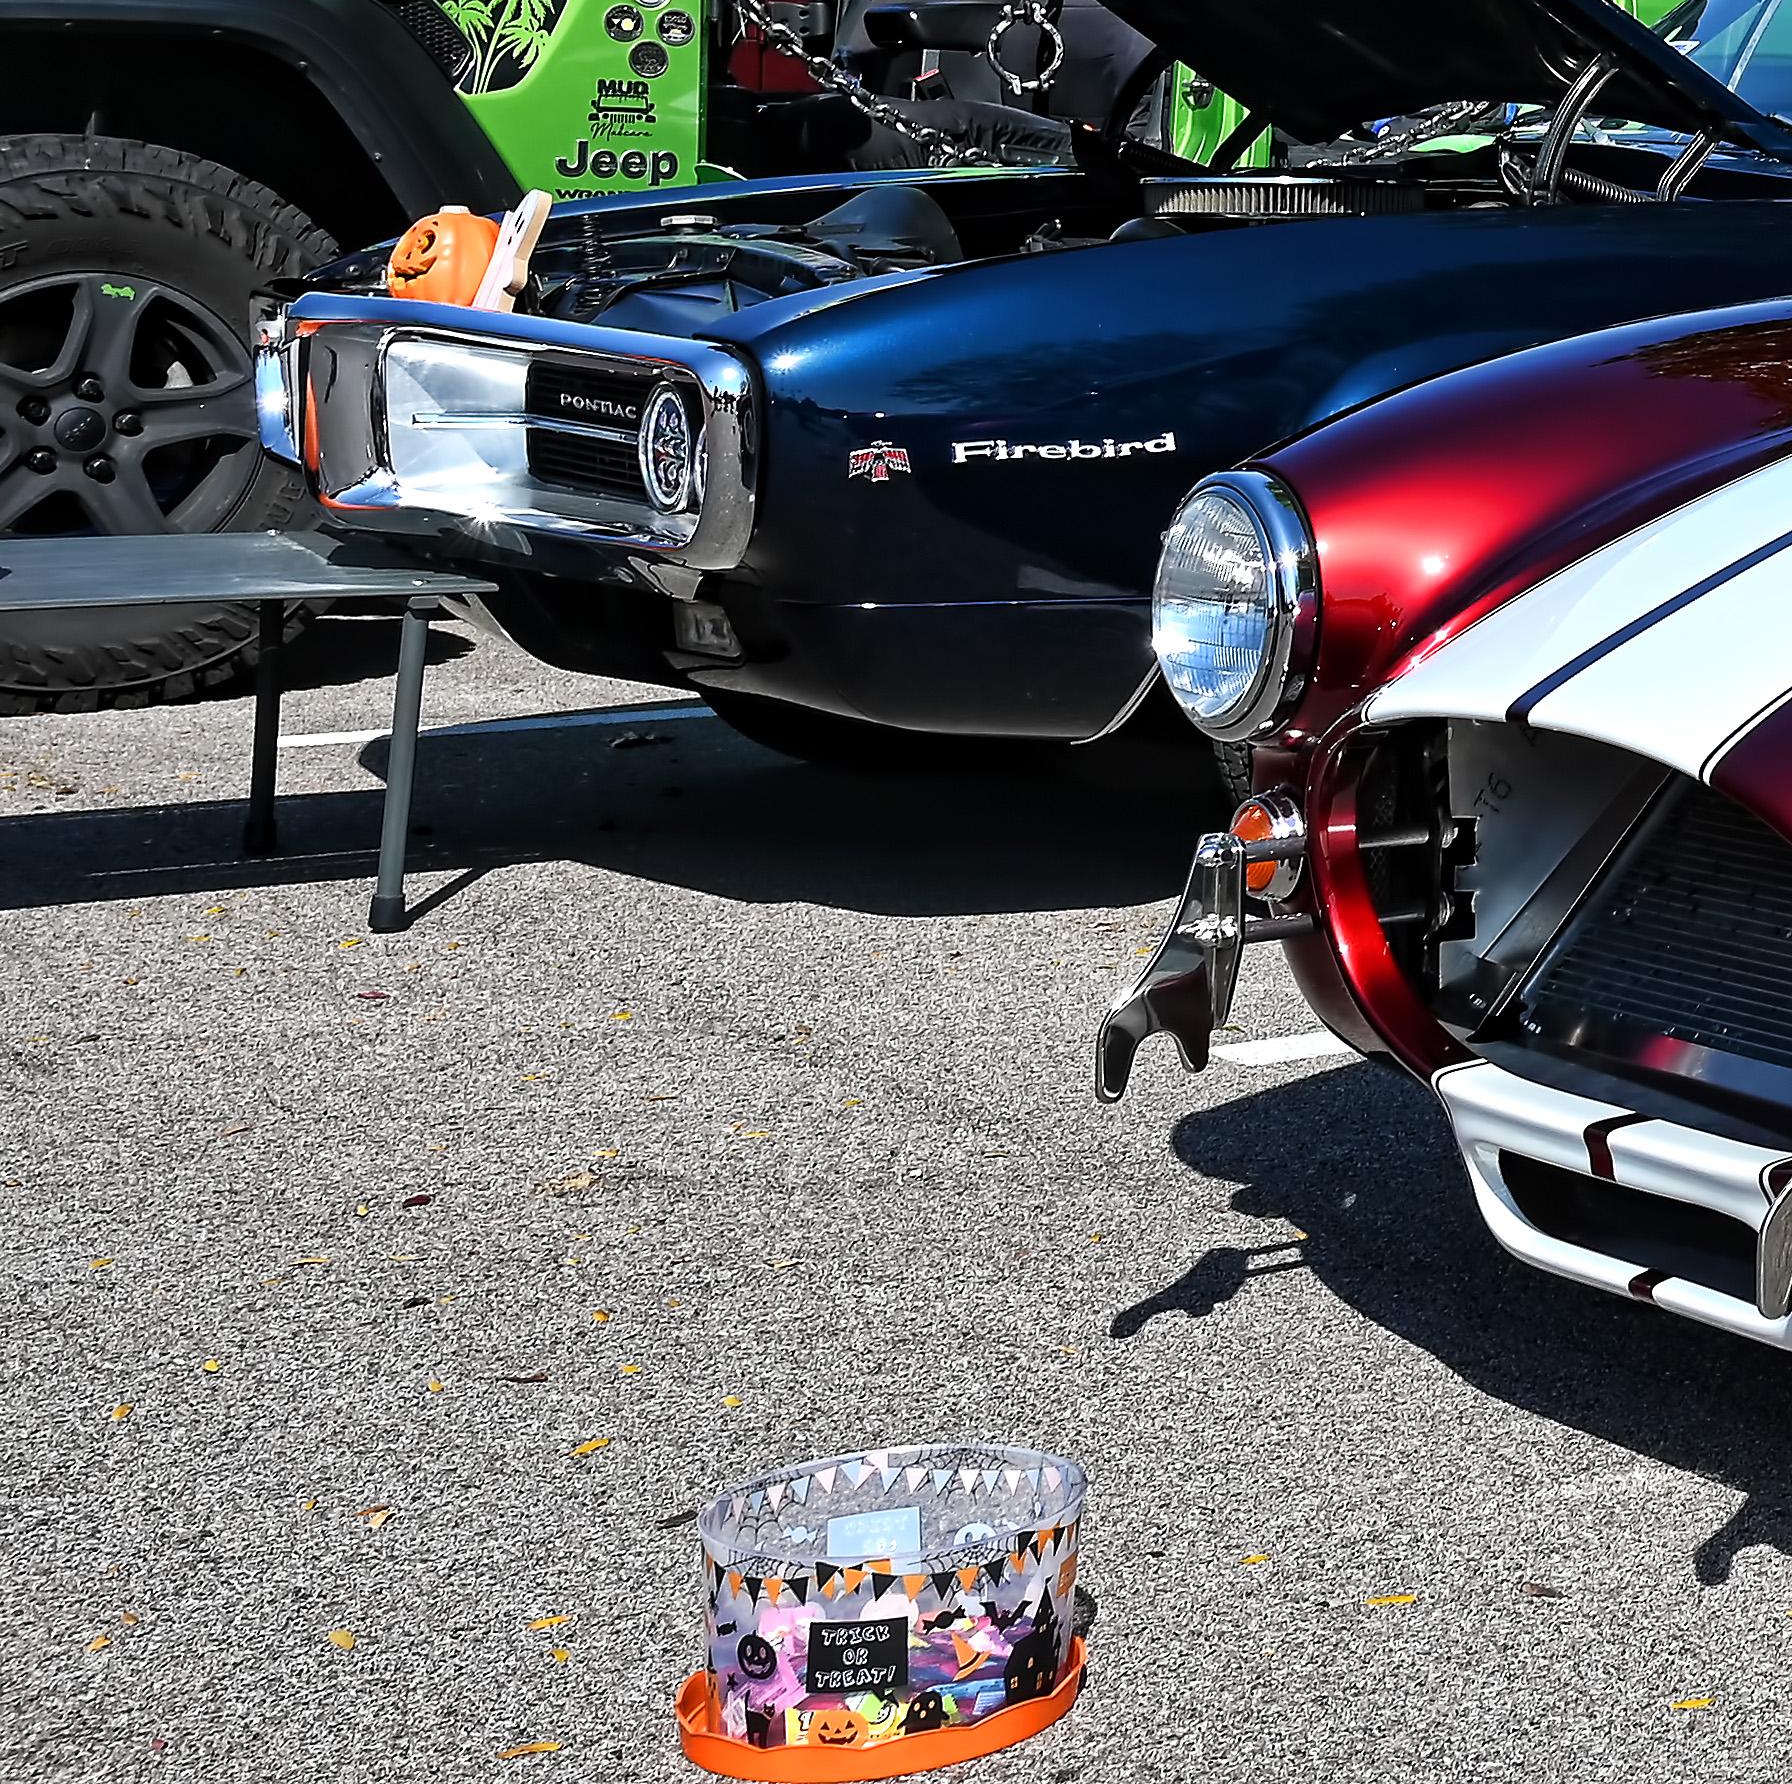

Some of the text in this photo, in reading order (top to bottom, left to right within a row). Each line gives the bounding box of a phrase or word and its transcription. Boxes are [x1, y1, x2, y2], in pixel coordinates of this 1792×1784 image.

[597, 78, 650, 96] MUD
[555, 138, 680, 187] Jeep
[560, 392, 638, 420] PONTIAC
[951, 431, 1177, 464] Firebird
[821, 1625, 891, 1646] TRICK
[842, 1647, 869, 1666] OR
[814, 1665, 897, 1689] TREAT!
